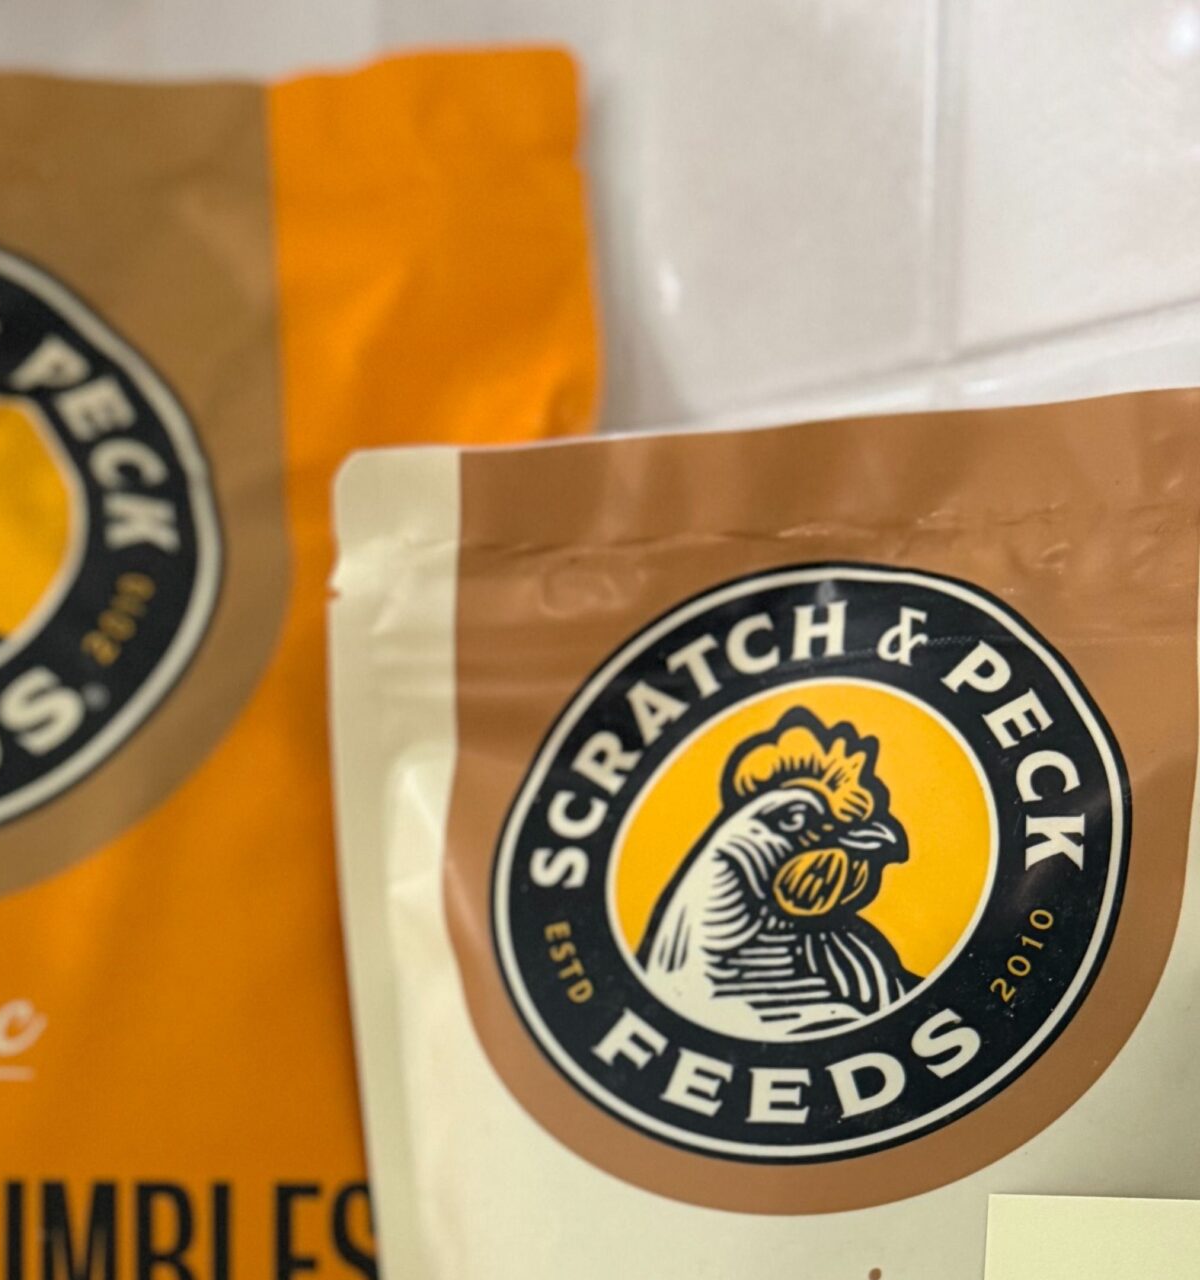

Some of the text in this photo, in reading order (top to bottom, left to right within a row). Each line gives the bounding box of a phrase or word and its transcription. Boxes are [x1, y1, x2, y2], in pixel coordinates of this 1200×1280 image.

[10, 335, 182, 555] PECK
[530, 601, 1084, 888] SCRATCH & PECK
[545, 921, 594, 1005] ESTD
[989, 909, 1053, 1002] 2010
[593, 1008, 981, 1123] FEEDS
